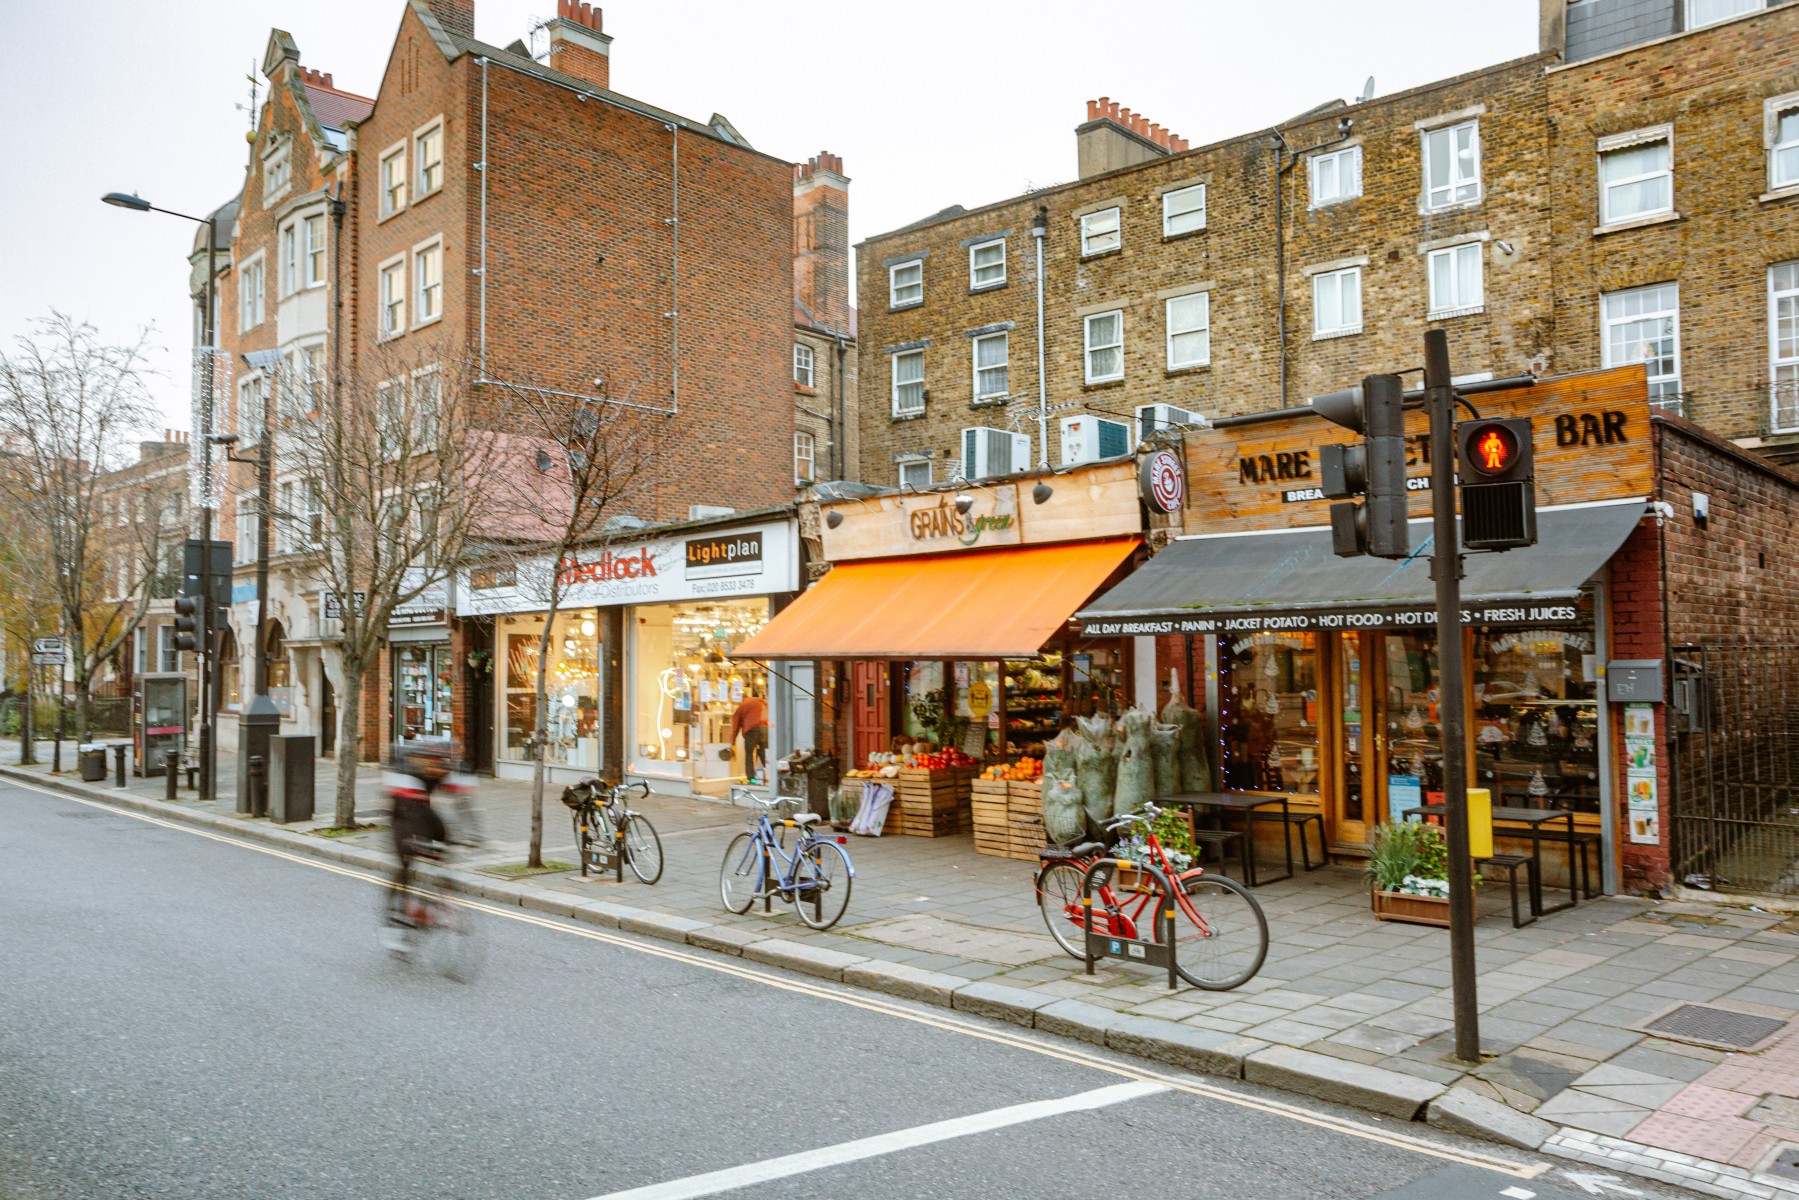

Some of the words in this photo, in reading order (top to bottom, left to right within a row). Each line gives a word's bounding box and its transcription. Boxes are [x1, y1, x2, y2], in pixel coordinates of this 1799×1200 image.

[1239, 451, 1312, 484] MARE
[1555, 411, 1628, 446] BAR
[910, 506, 965, 540] GRAINS
[688, 539, 759, 564] Lightplan
[1085, 624, 1101, 634] ALL
[1102, 623, 1122, 634] DAY
[1122, 621, 1173, 633] BREAKFAST
[1181, 620, 1215, 632] PANINI
[1224, 618, 1261, 631] JACKET
[1263, 616, 1309, 629] POTATO
[1318, 614, 1345, 627] HOT
[1346, 613, 1384, 626] FOOD
[1394, 612, 1422, 625] HOT
[1483, 607, 1525, 622] FRESH
[1527, 605, 1576, 621] JUICES
